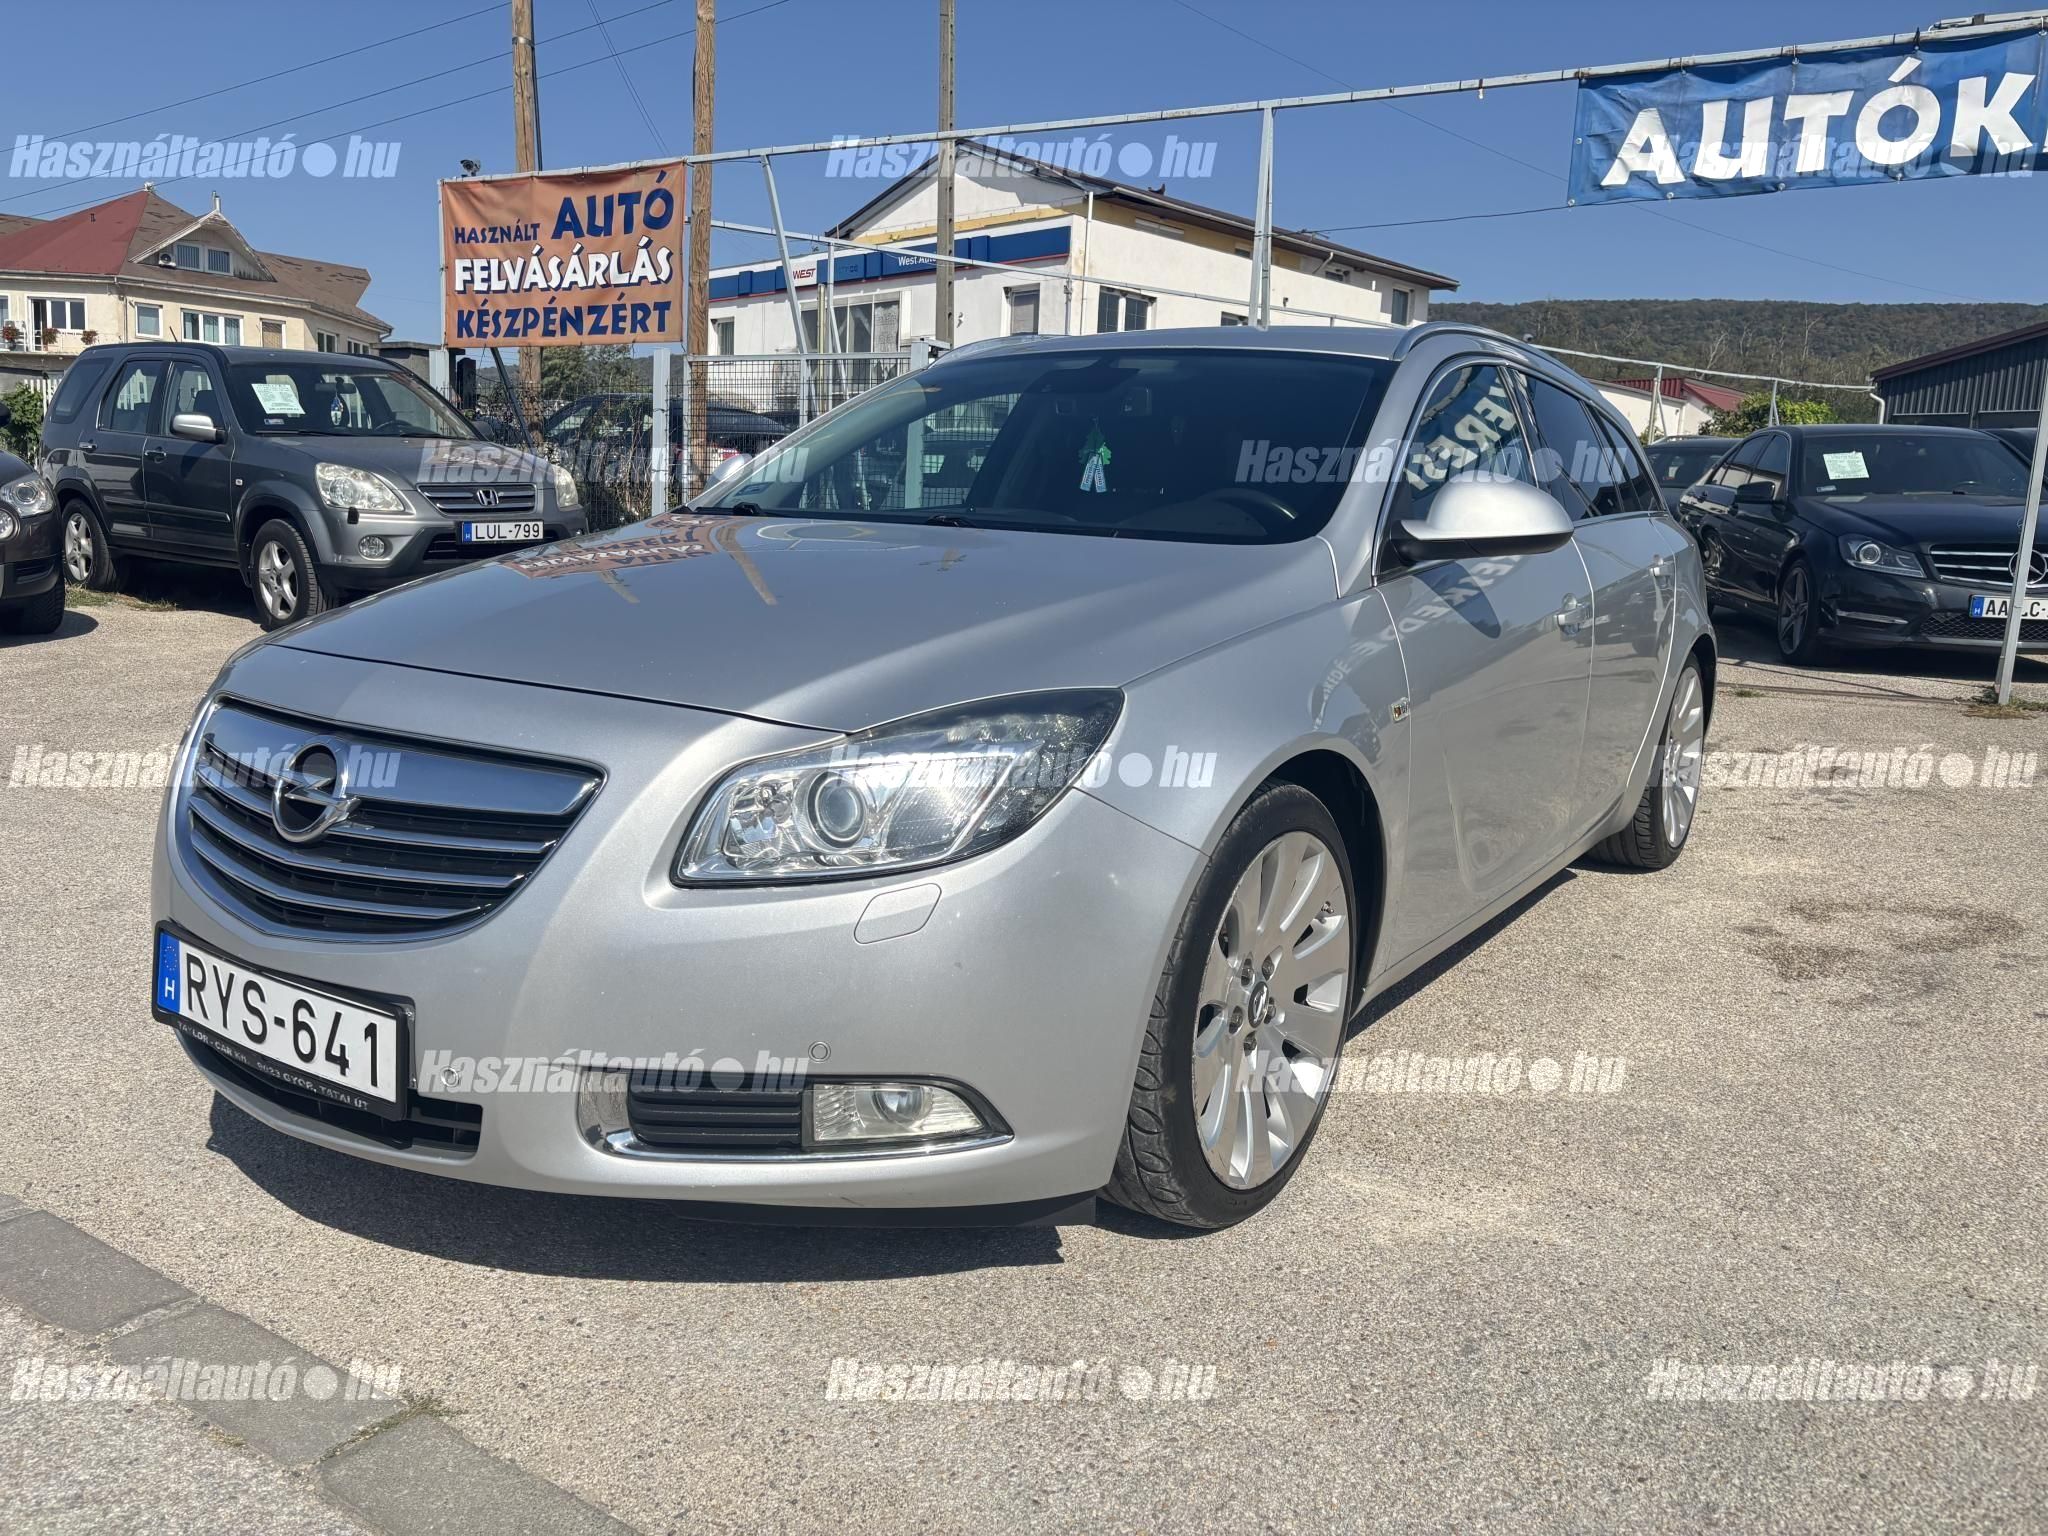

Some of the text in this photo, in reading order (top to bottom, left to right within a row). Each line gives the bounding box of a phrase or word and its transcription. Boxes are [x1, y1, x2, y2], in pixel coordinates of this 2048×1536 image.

[1600, 56, 2048, 186] AUTÓK
[454, 170, 675, 244] HASZNÁLT AUTÓ
[454, 235, 674, 294] FELVÁSÁRLÁS
[793, 268, 816, 279] WEST
[898, 256, 917, 266] West
[457, 292, 672, 339] KÉSZPÉNZÉRT
[475, 524, 540, 539] LUL-799
[164, 952, 379, 1088] H RYS-641
